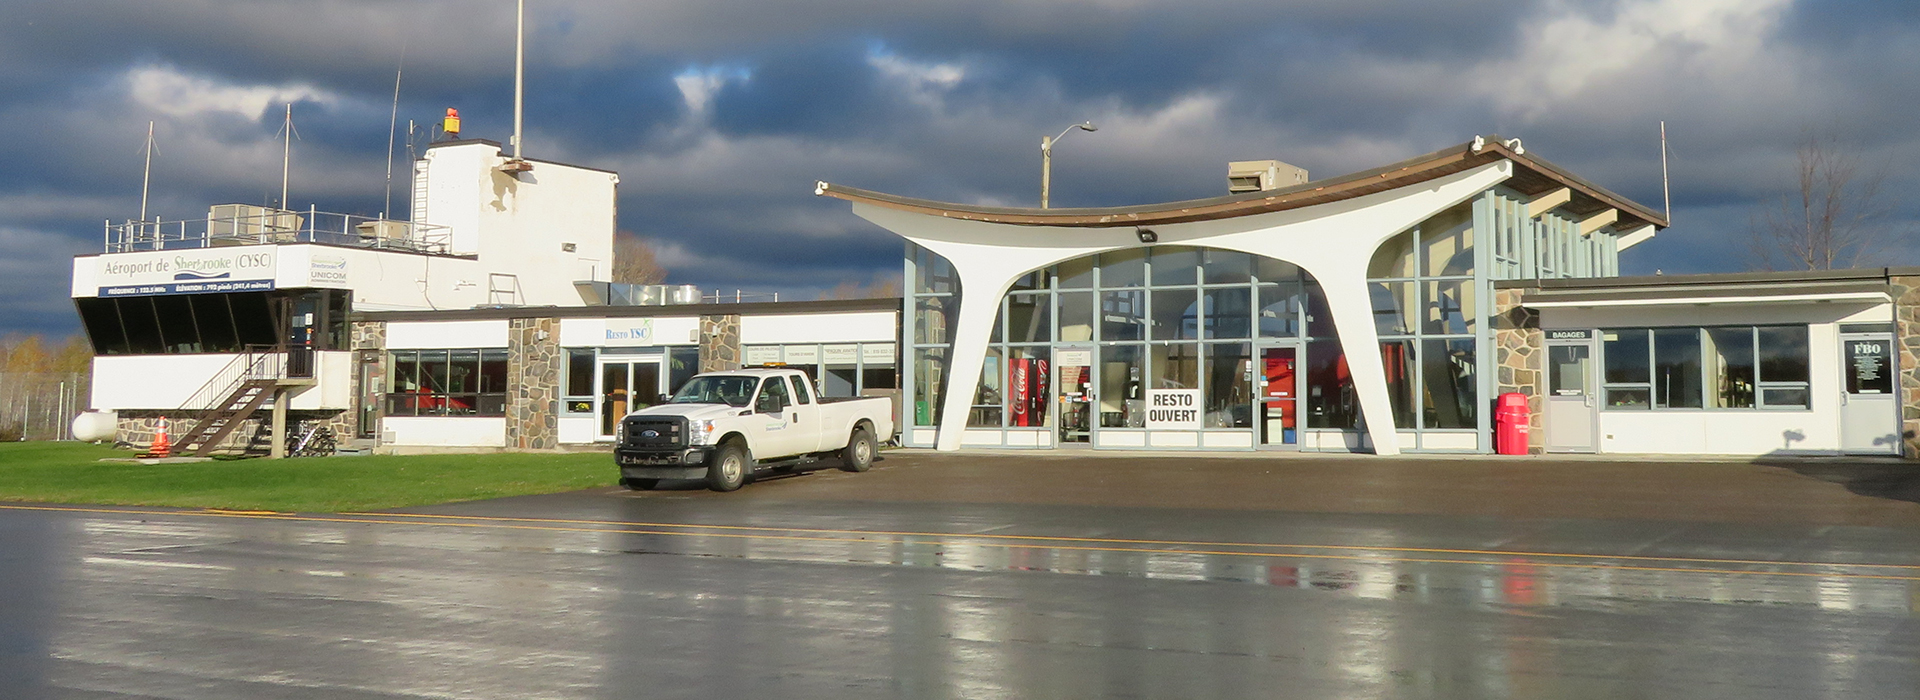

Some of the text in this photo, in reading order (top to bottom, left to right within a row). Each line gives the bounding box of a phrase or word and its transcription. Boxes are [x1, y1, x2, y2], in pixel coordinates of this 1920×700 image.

[104, 253, 272, 277] Aéroport de Sherbrooke (CYSC)
[311, 271, 346, 279] UNICOM
[630, 328, 647, 339] YSC
[1552, 331, 1586, 339] BAGAGES
[1854, 344, 1881, 355] FBO
[1011, 366, 1026, 415] Coca-Cola
[1153, 394, 1193, 406] RESTO
[1149, 409, 1197, 422] OUVERT
